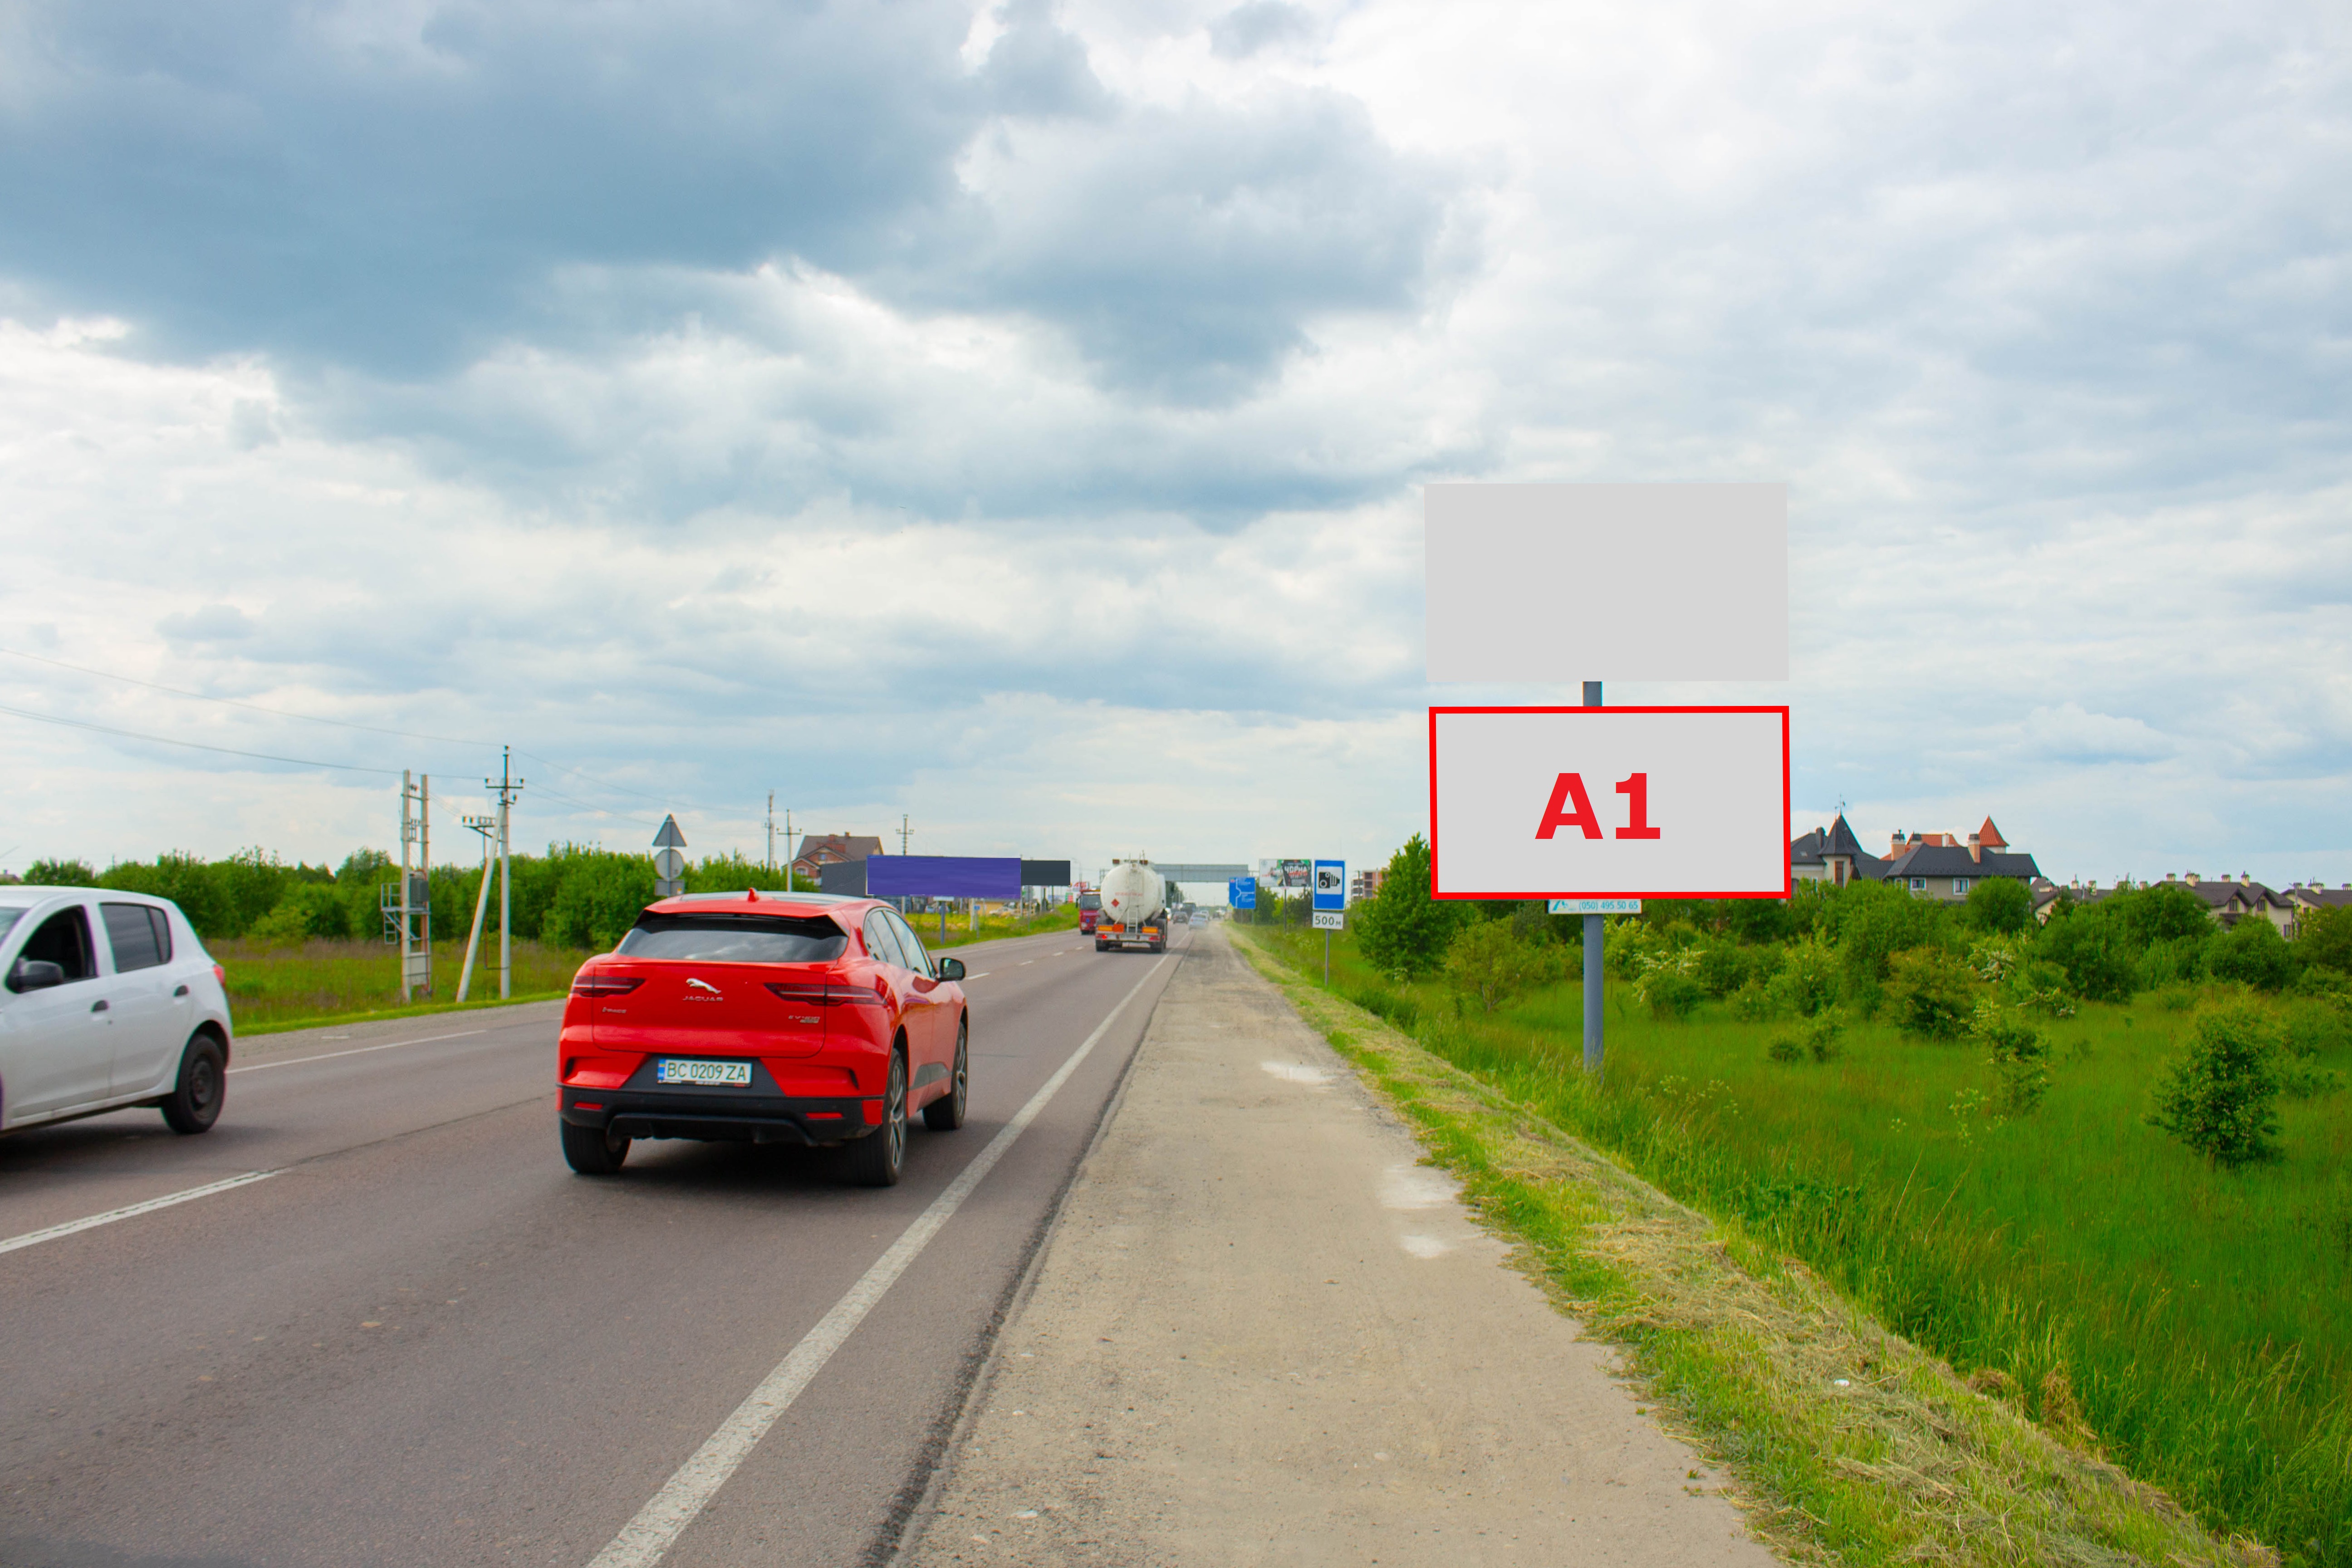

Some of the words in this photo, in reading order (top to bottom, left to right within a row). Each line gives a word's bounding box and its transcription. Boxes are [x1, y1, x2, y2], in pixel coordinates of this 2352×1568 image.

[1579, 901, 1598, 910] (050)
[1601, 901, 1614, 910] 495
[1617, 901, 1626, 910] 50
[1629, 901, 1638, 910] 65
[1315, 916, 1334, 926] 500
[667, 1063, 687, 1078] BC
[691, 1063, 723, 1080] 0209
[726, 1065, 746, 1081] ZA
